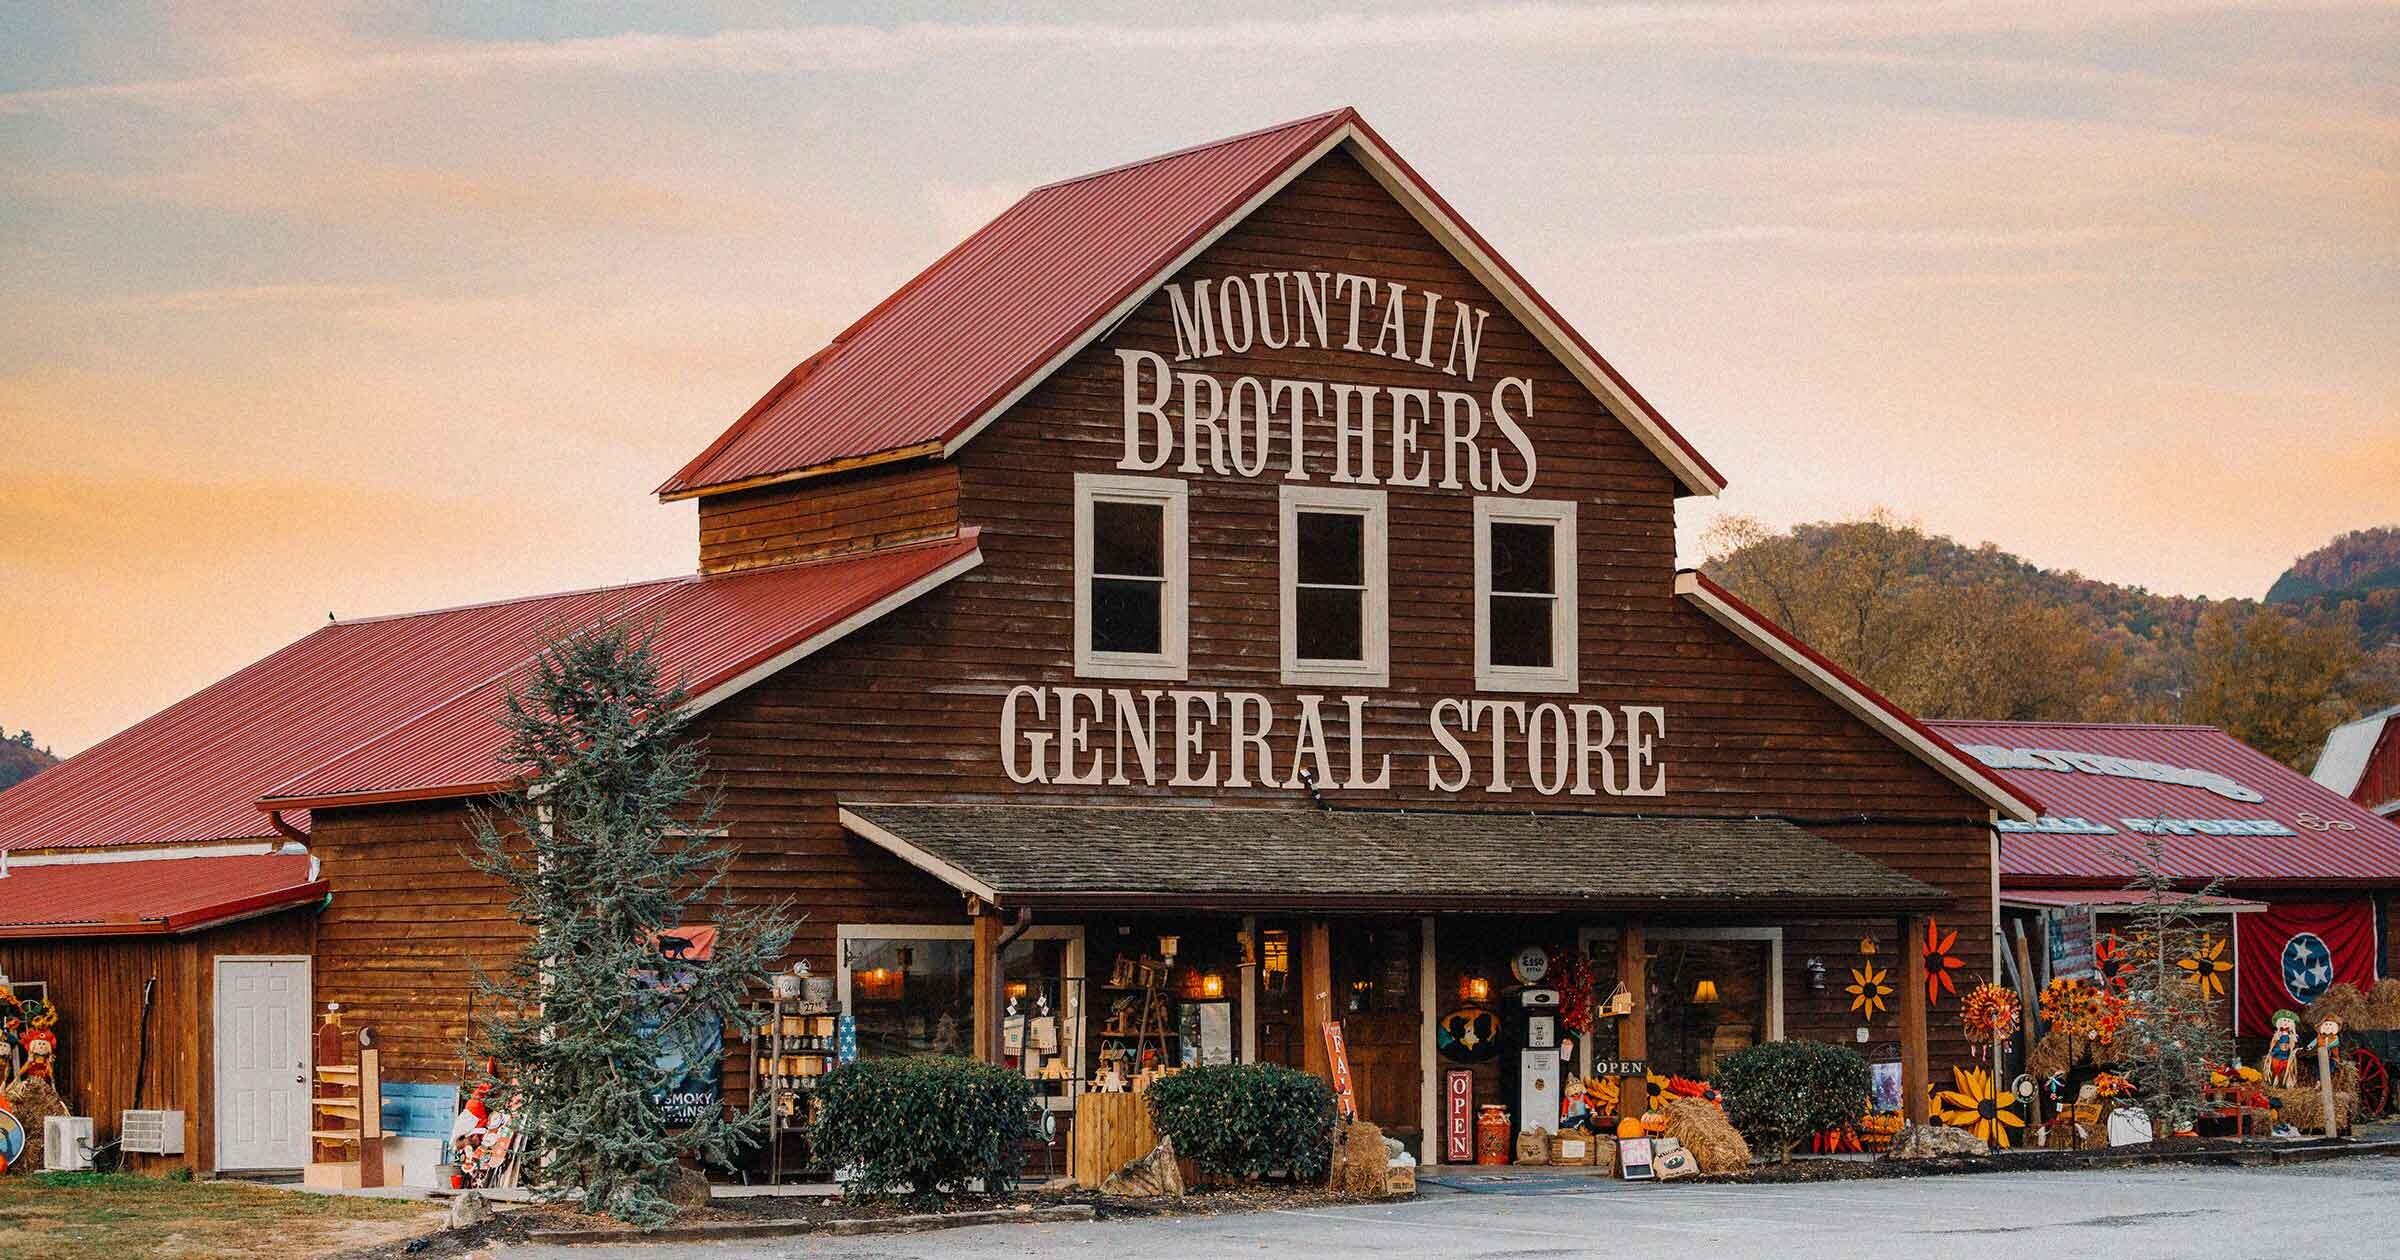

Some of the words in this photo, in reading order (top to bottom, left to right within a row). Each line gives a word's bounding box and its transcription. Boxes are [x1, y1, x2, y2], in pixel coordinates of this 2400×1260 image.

[1163, 271, 1490, 382] MOUNTAIN
[1114, 348, 1536, 494] BROTHERS
[1001, 684, 1390, 790] GENERAL
[1427, 697, 1666, 797] STORE
[664, 1093, 713, 1105] SMOKY
[1596, 1062, 1643, 1073] OPEN
[1453, 1078, 1466, 1153] OPEN
